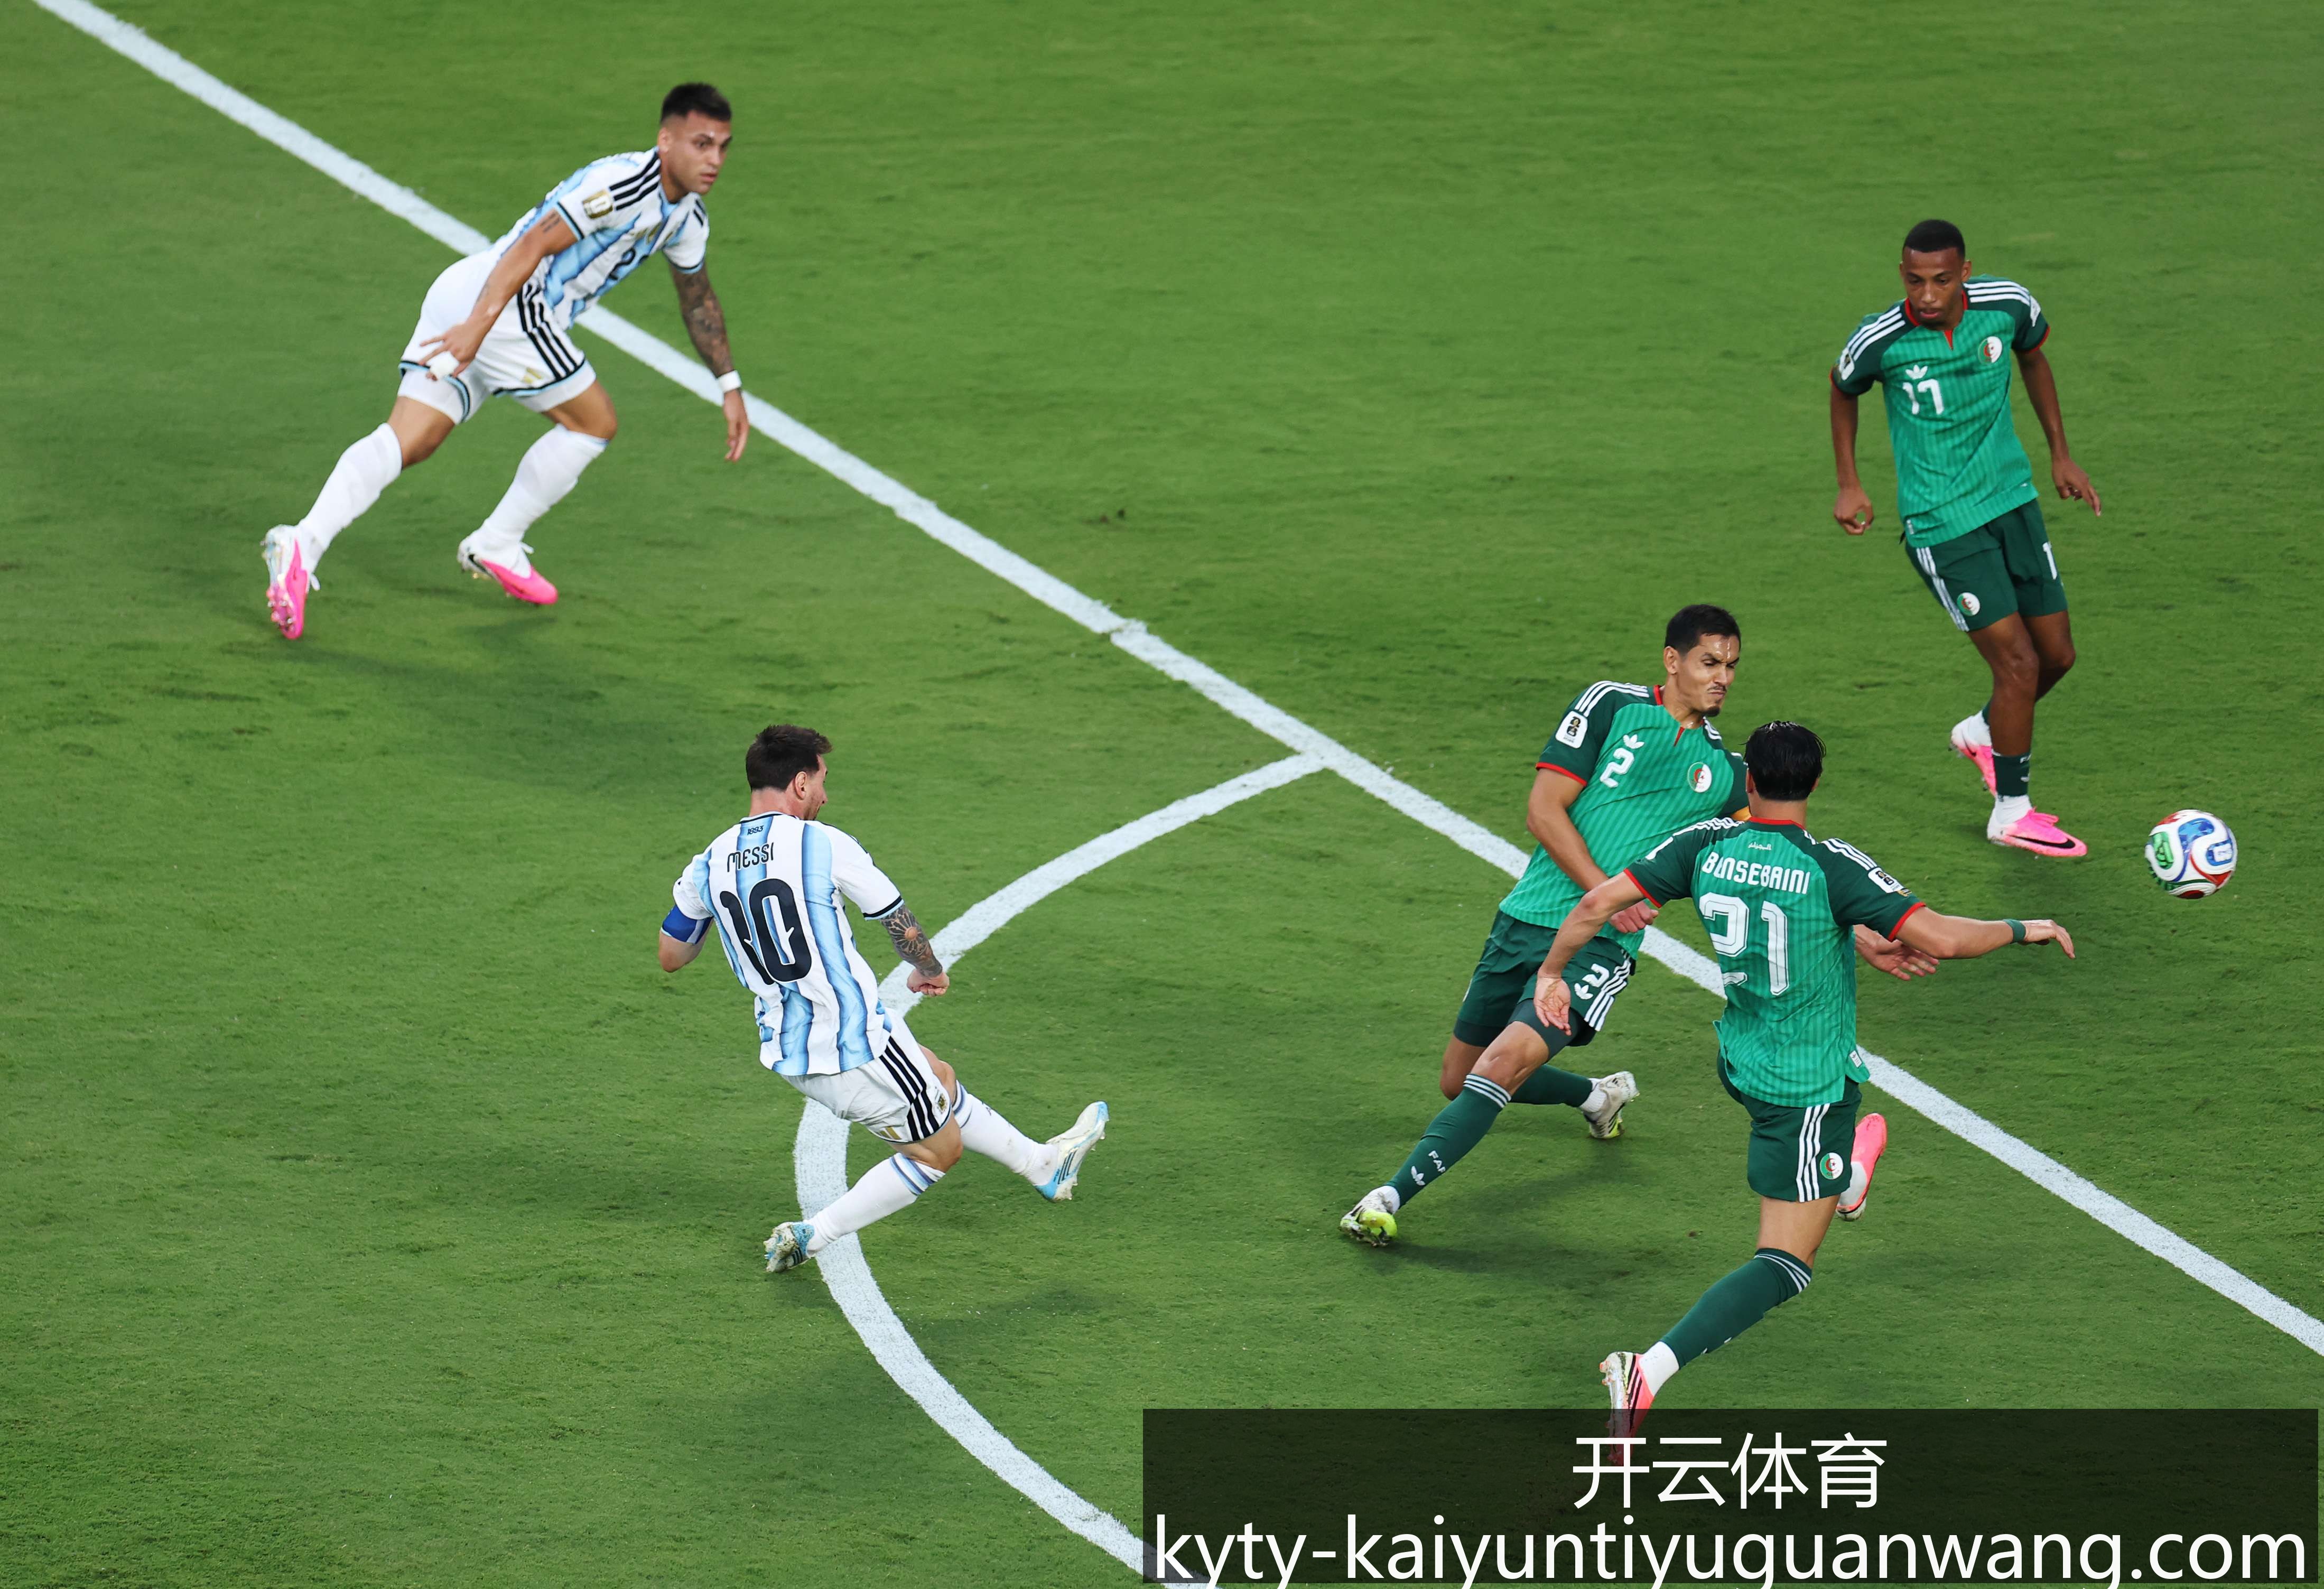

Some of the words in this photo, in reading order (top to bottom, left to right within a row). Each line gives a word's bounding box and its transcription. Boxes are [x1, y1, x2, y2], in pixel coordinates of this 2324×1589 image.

[1902, 378, 1944, 415] 17
[2042, 542, 2057, 580] 1
[1600, 747, 1634, 788] 2
[747, 825, 764, 835] 1893
[727, 842, 774, 872] MESSI
[720, 878, 812, 985] 10
[1699, 891, 1789, 996] 21
